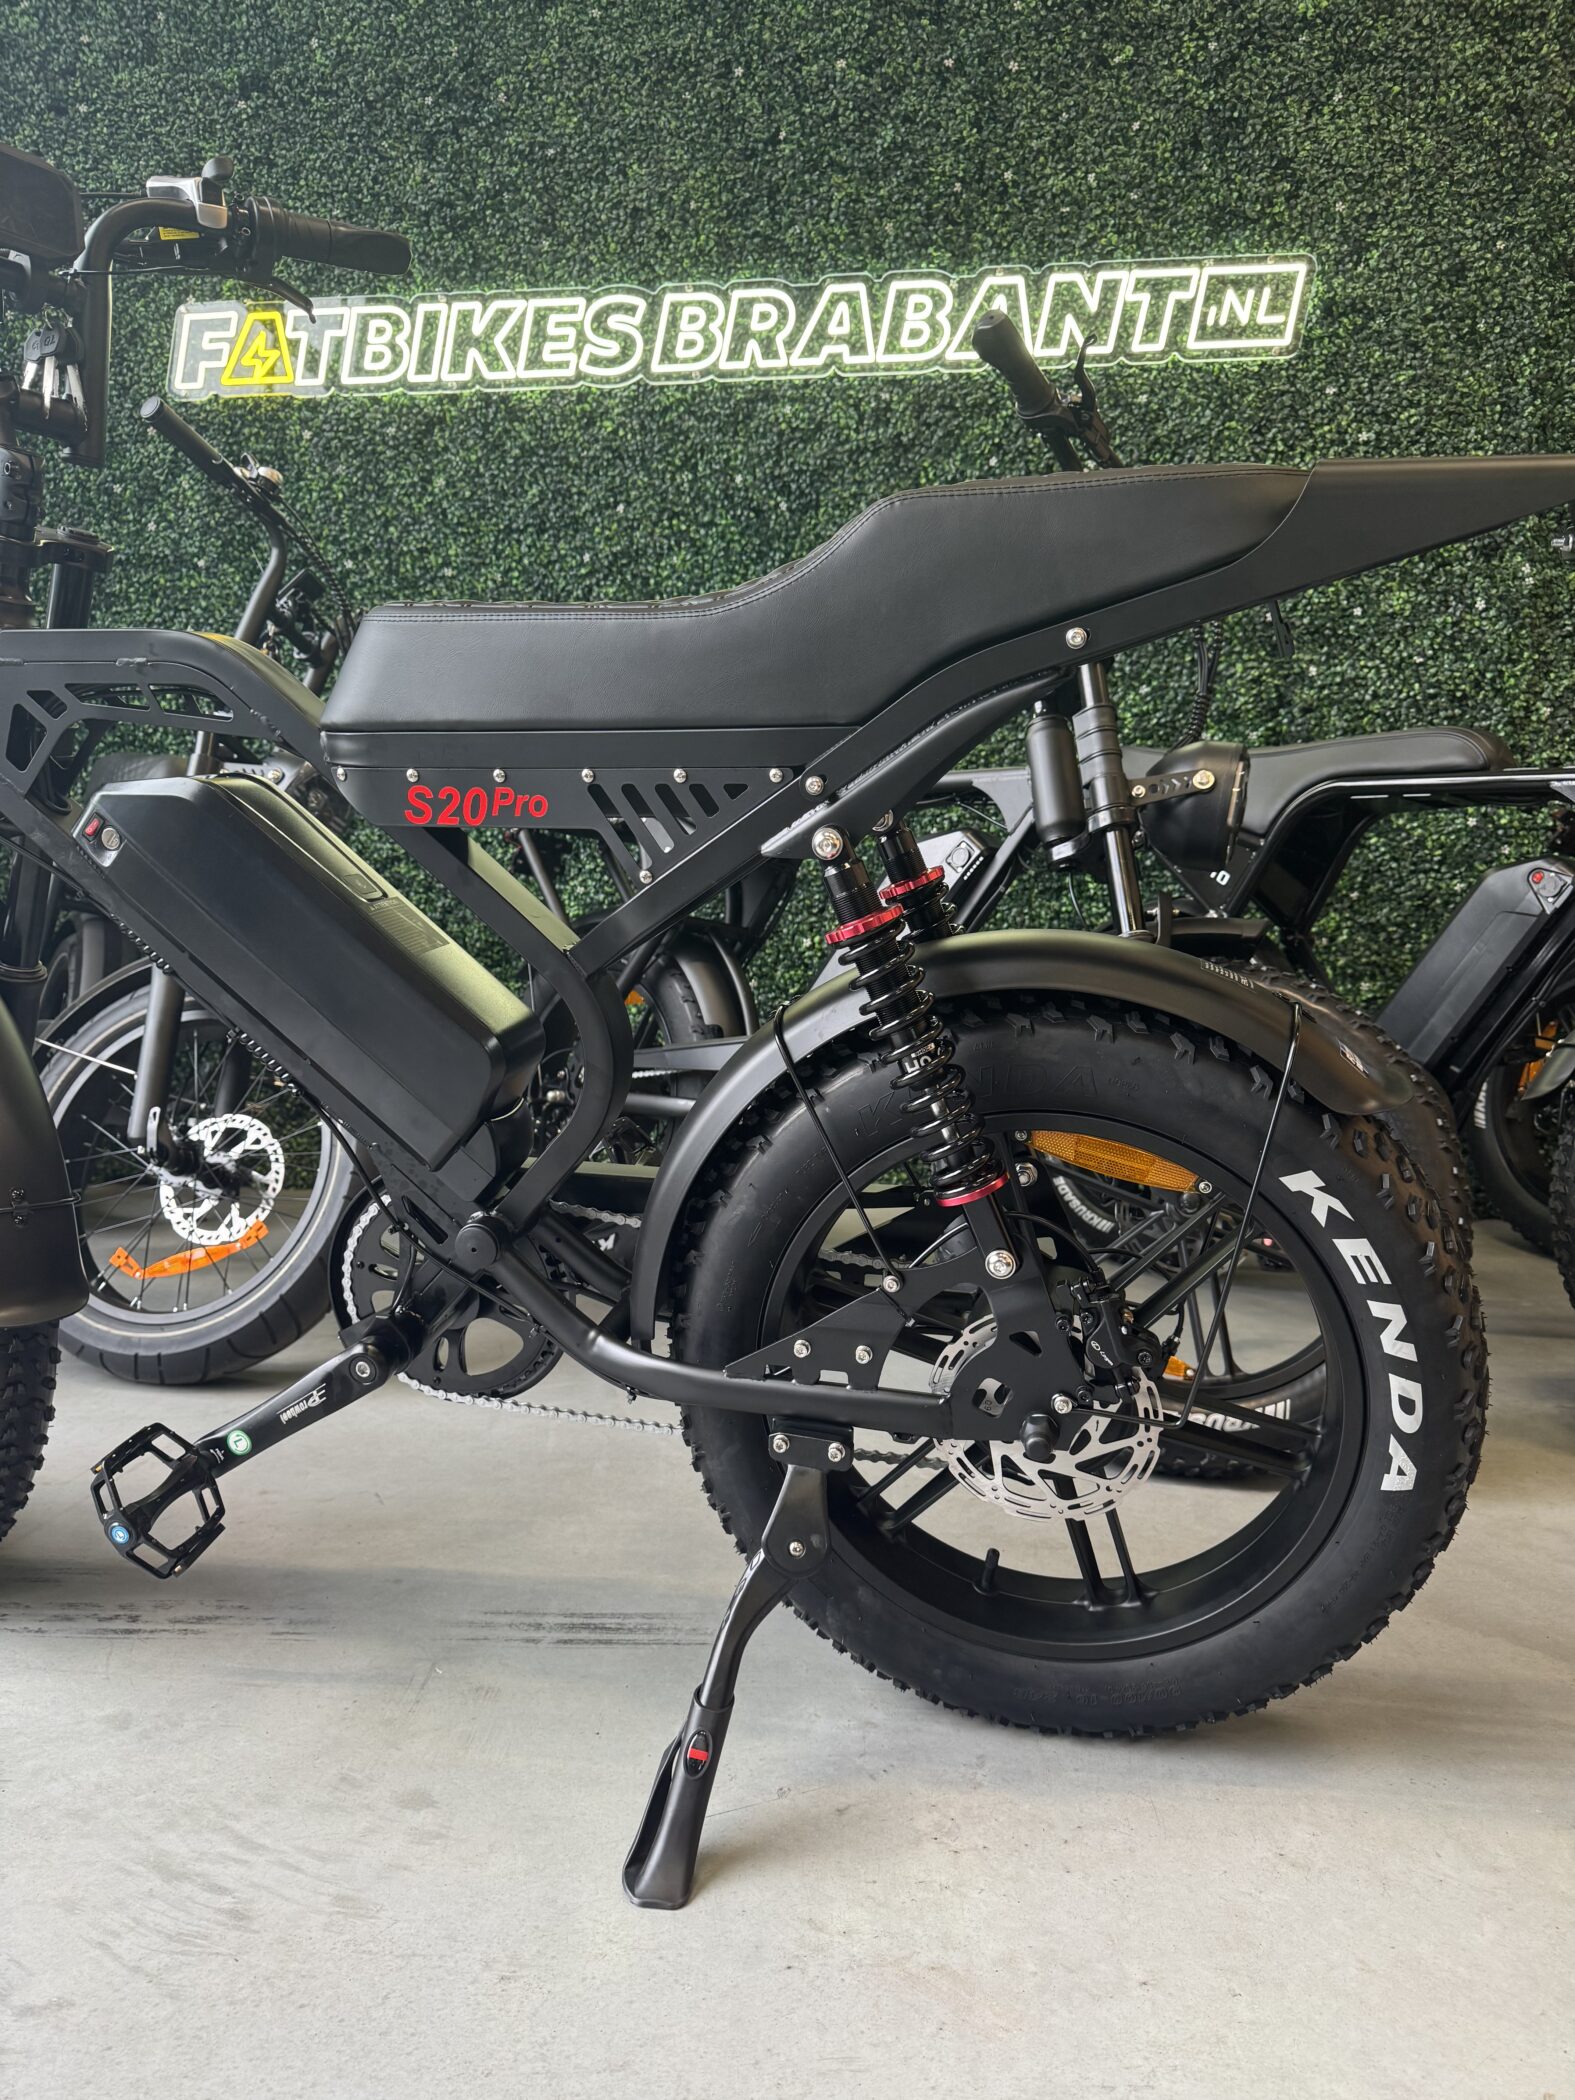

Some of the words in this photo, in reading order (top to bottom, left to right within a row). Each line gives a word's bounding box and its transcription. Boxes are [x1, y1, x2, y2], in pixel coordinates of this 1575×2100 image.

[404, 784, 489, 827] S20
[491, 786, 549, 818] Pro
[1278, 1169, 1424, 1491] KENDA
[279, 1383, 327, 1425] Prowheel
